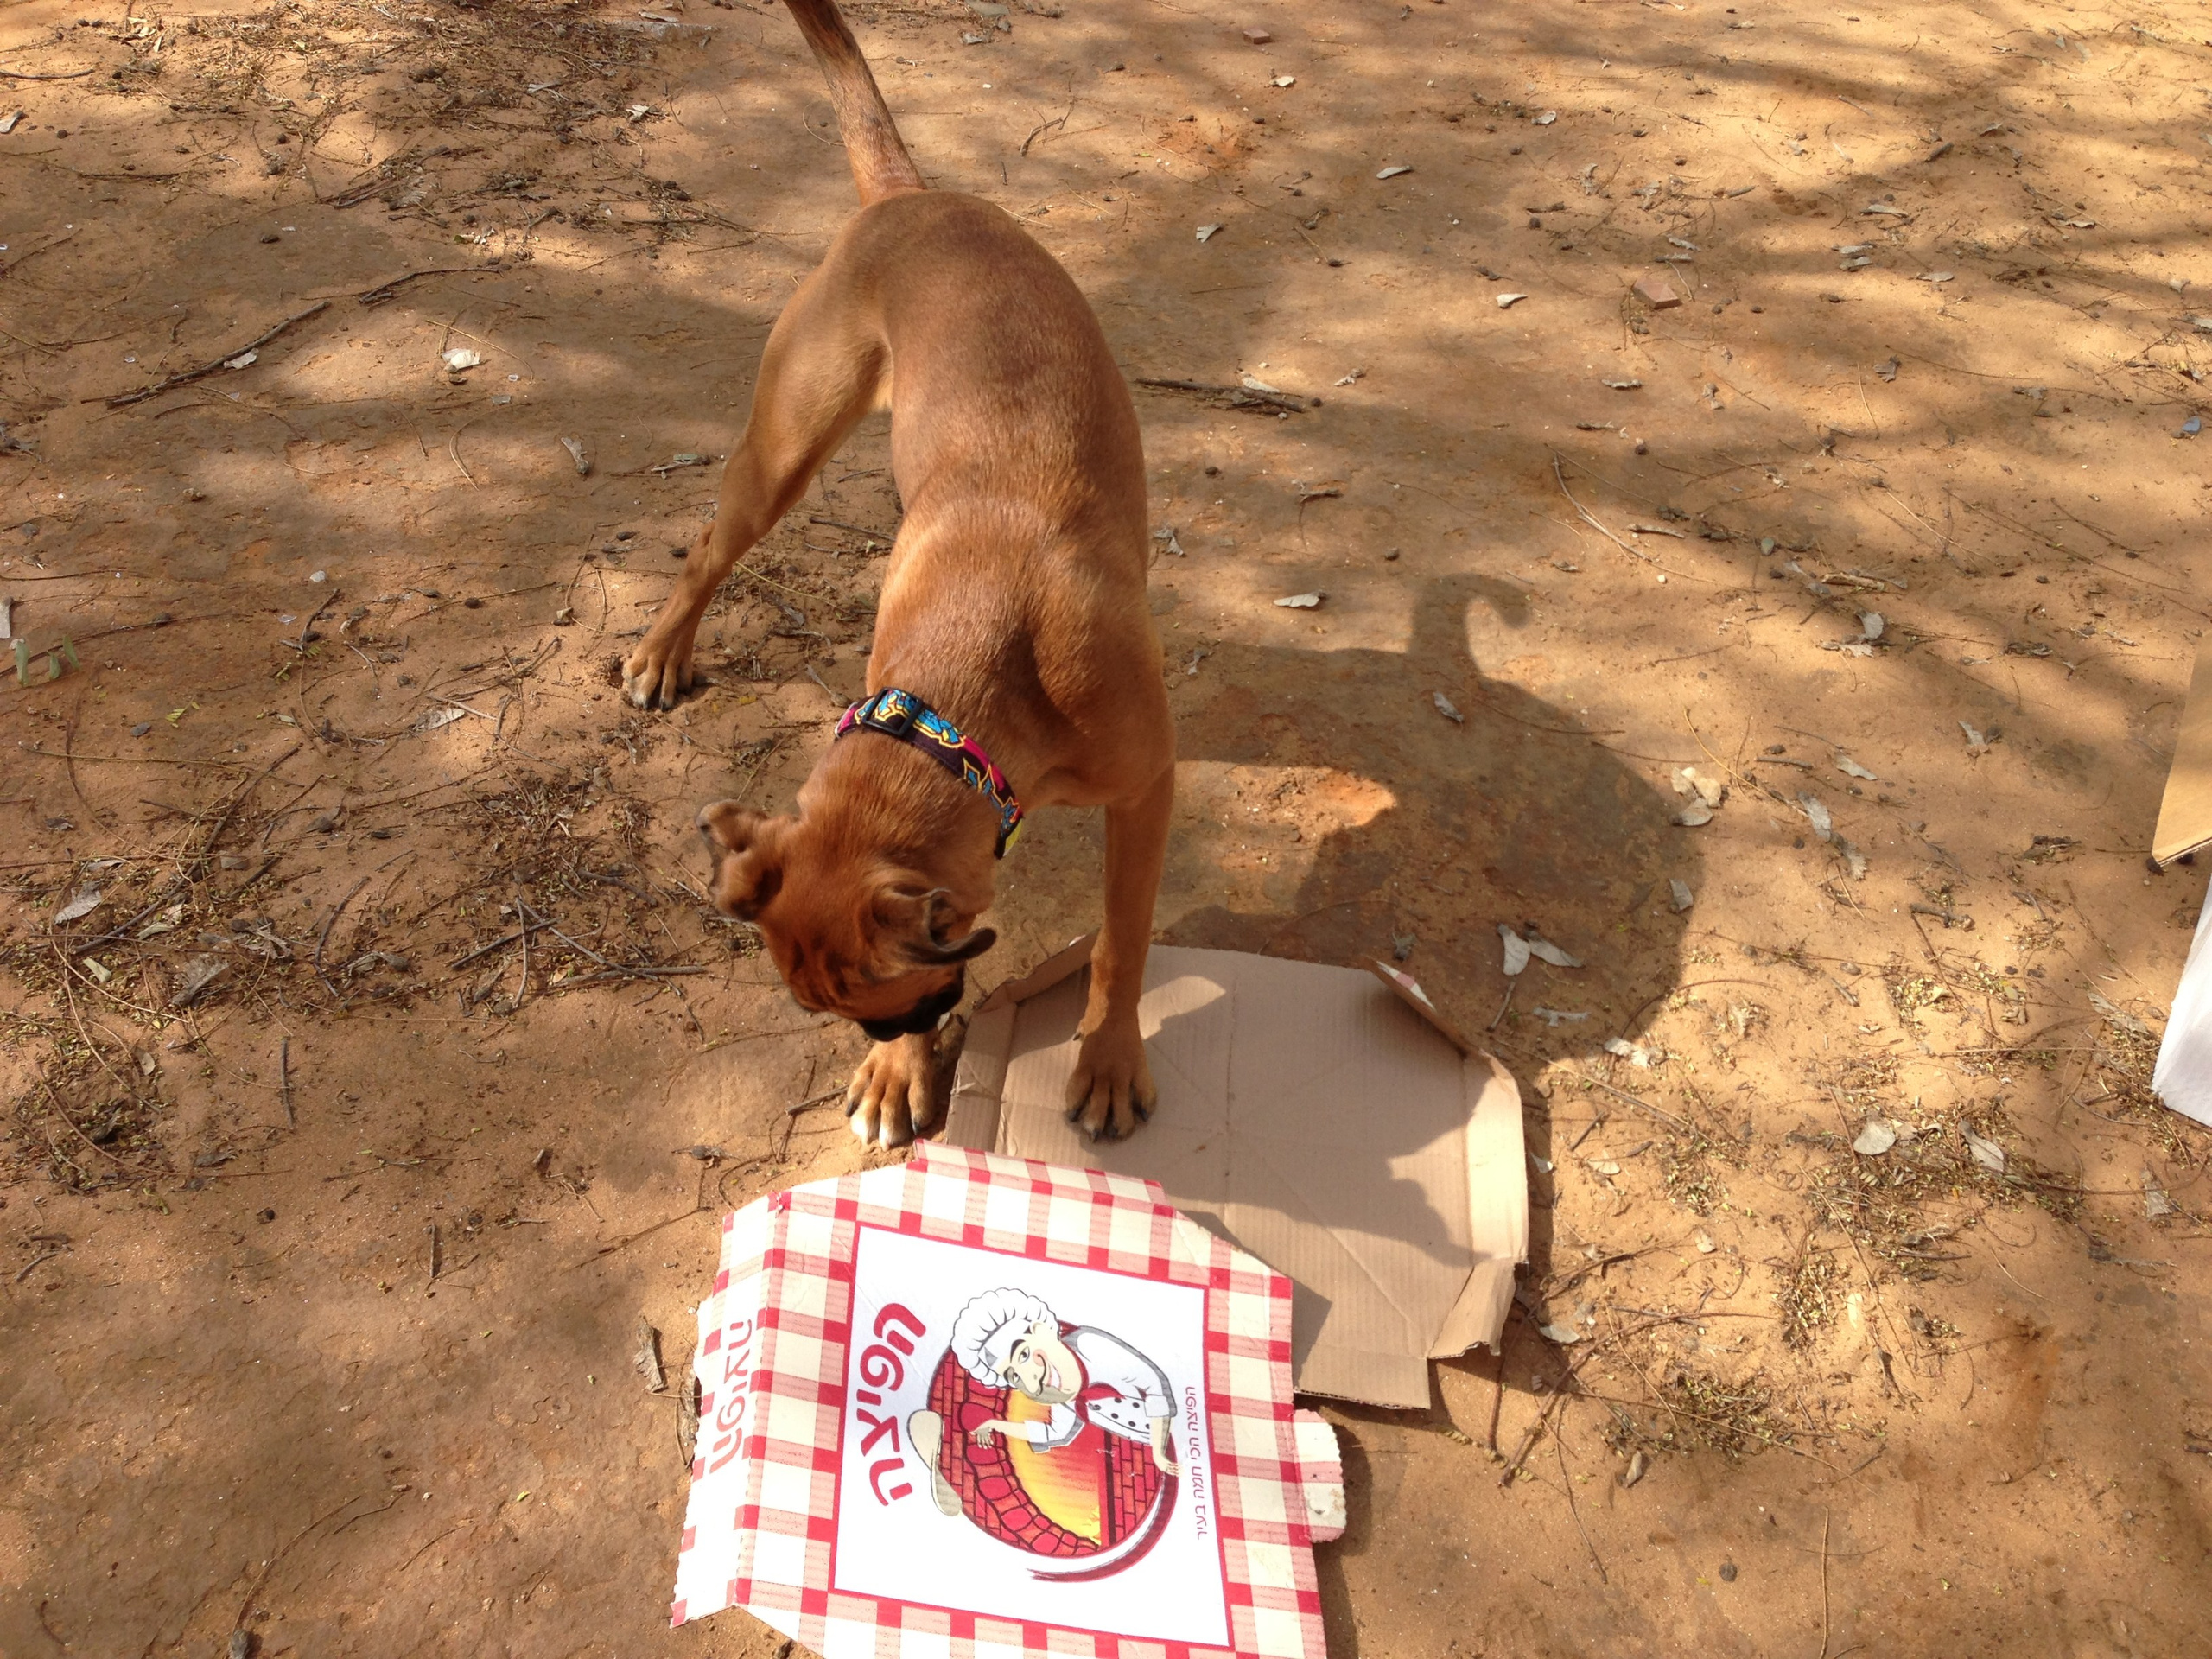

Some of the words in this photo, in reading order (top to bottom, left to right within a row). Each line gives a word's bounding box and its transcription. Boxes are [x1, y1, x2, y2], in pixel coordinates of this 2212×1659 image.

[709, 1318, 753, 1474] הפיצה
[855, 1302, 927, 1507] הפיצה
[1184, 1386, 1199, 1432] הפיצה
[1187, 1437, 1201, 1461] הכי
[1190, 1466, 1205, 1499] חמה
[1194, 1504, 1208, 1541] בעיר
